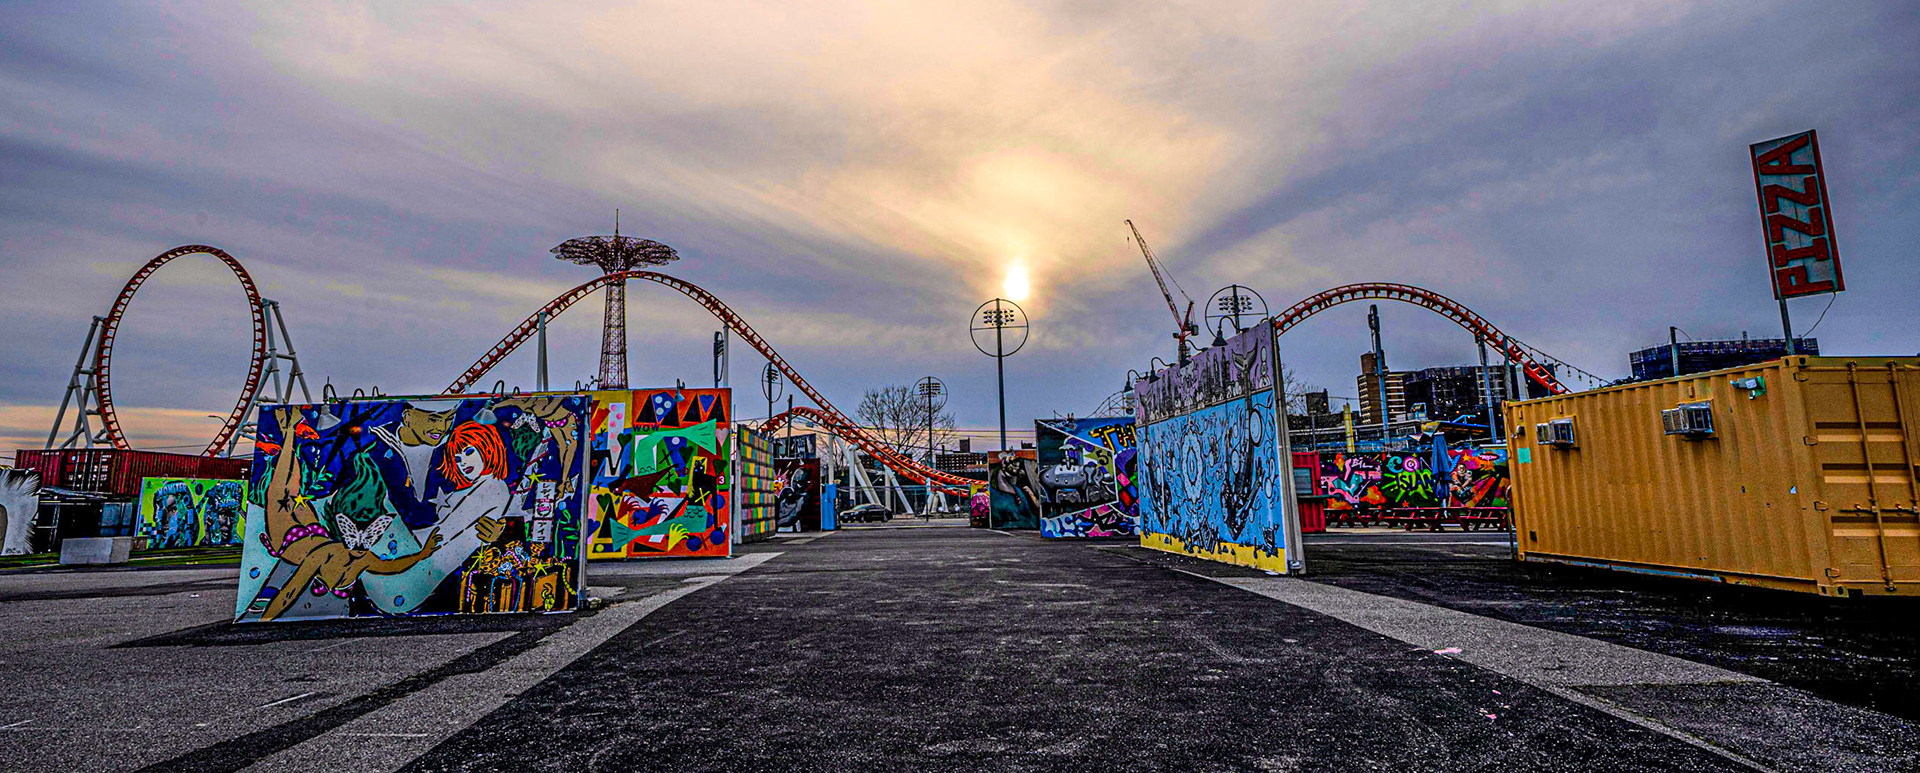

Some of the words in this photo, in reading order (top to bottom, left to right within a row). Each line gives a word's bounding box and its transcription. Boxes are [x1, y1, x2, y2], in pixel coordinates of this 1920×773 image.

[1757, 133, 1834, 296] PIZZA
[633, 424, 660, 432] WOW
[1386, 455, 1461, 473] CONY
[718, 475, 725, 485] 3
[1395, 473, 1438, 491] ISLAN
